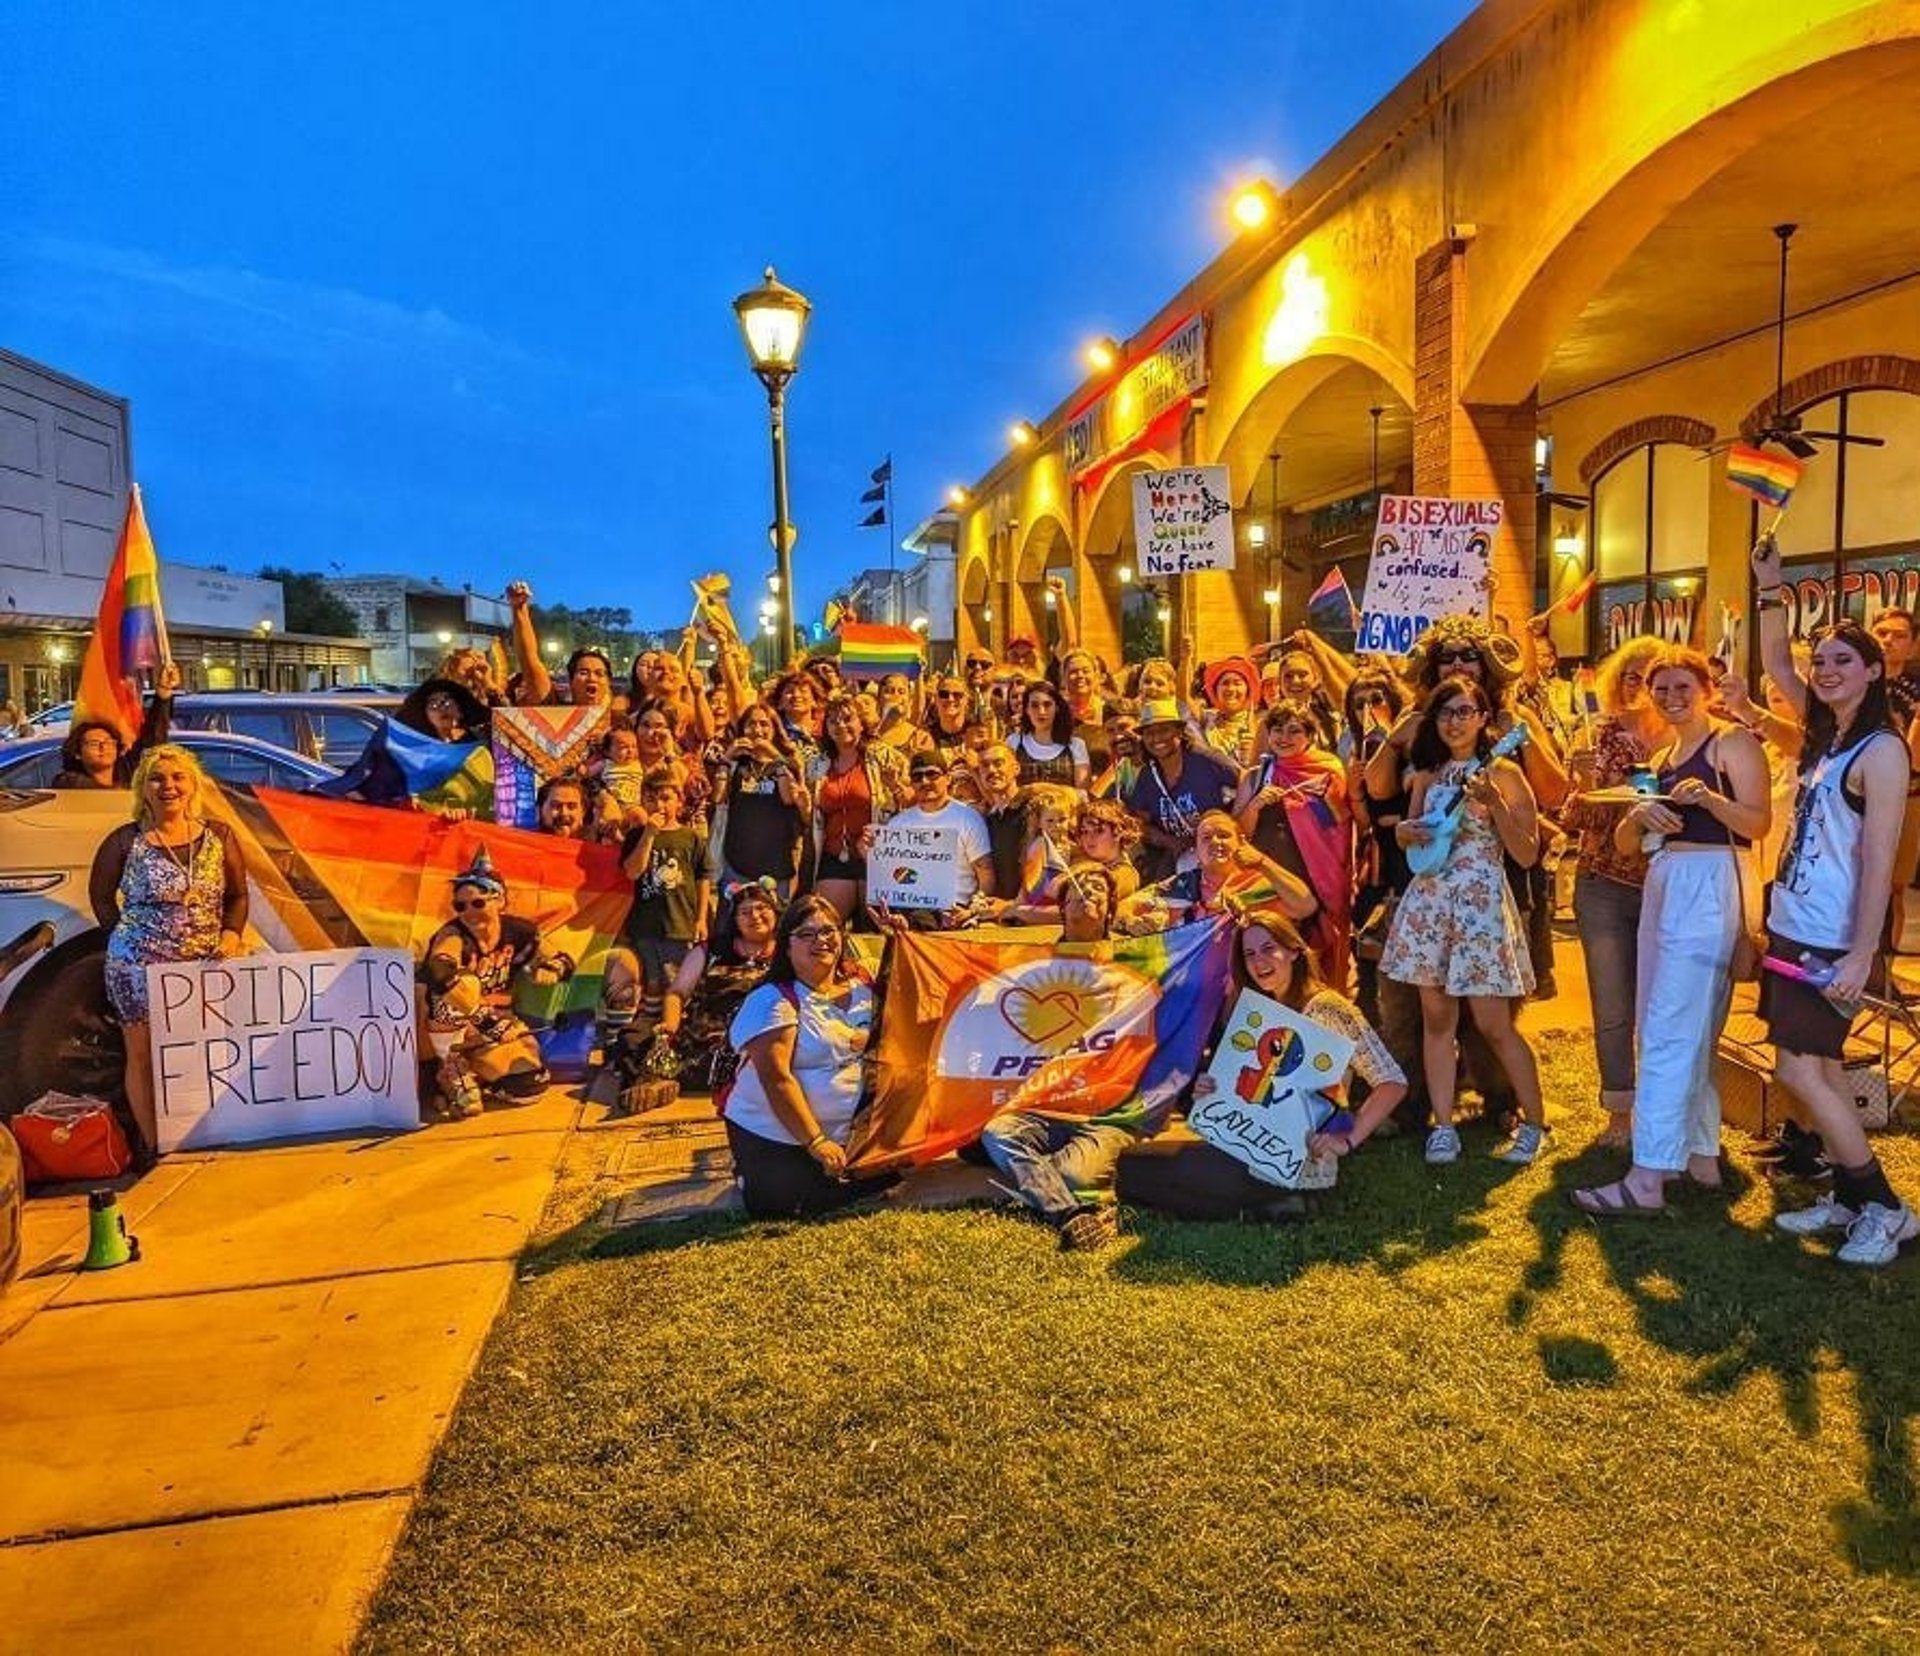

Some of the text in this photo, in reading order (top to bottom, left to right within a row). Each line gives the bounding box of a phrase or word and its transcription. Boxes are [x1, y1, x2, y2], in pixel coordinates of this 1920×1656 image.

[1144, 472, 1205, 490] We're
[1151, 491, 1200, 508] Here
[1150, 507, 1200, 524] We're
[1380, 498, 1501, 527] BISEXUALS
[1147, 538, 1216, 554] We have
[1147, 555, 1175, 573] No
[1610, 598, 1694, 651] NOW
[905, 828, 931, 846] THE
[161, 961, 336, 1033] PRIDE
[357, 959, 409, 1022] IS
[991, 1030, 1117, 1077] PFAG
[159, 1021, 417, 1116] FREEDOM
